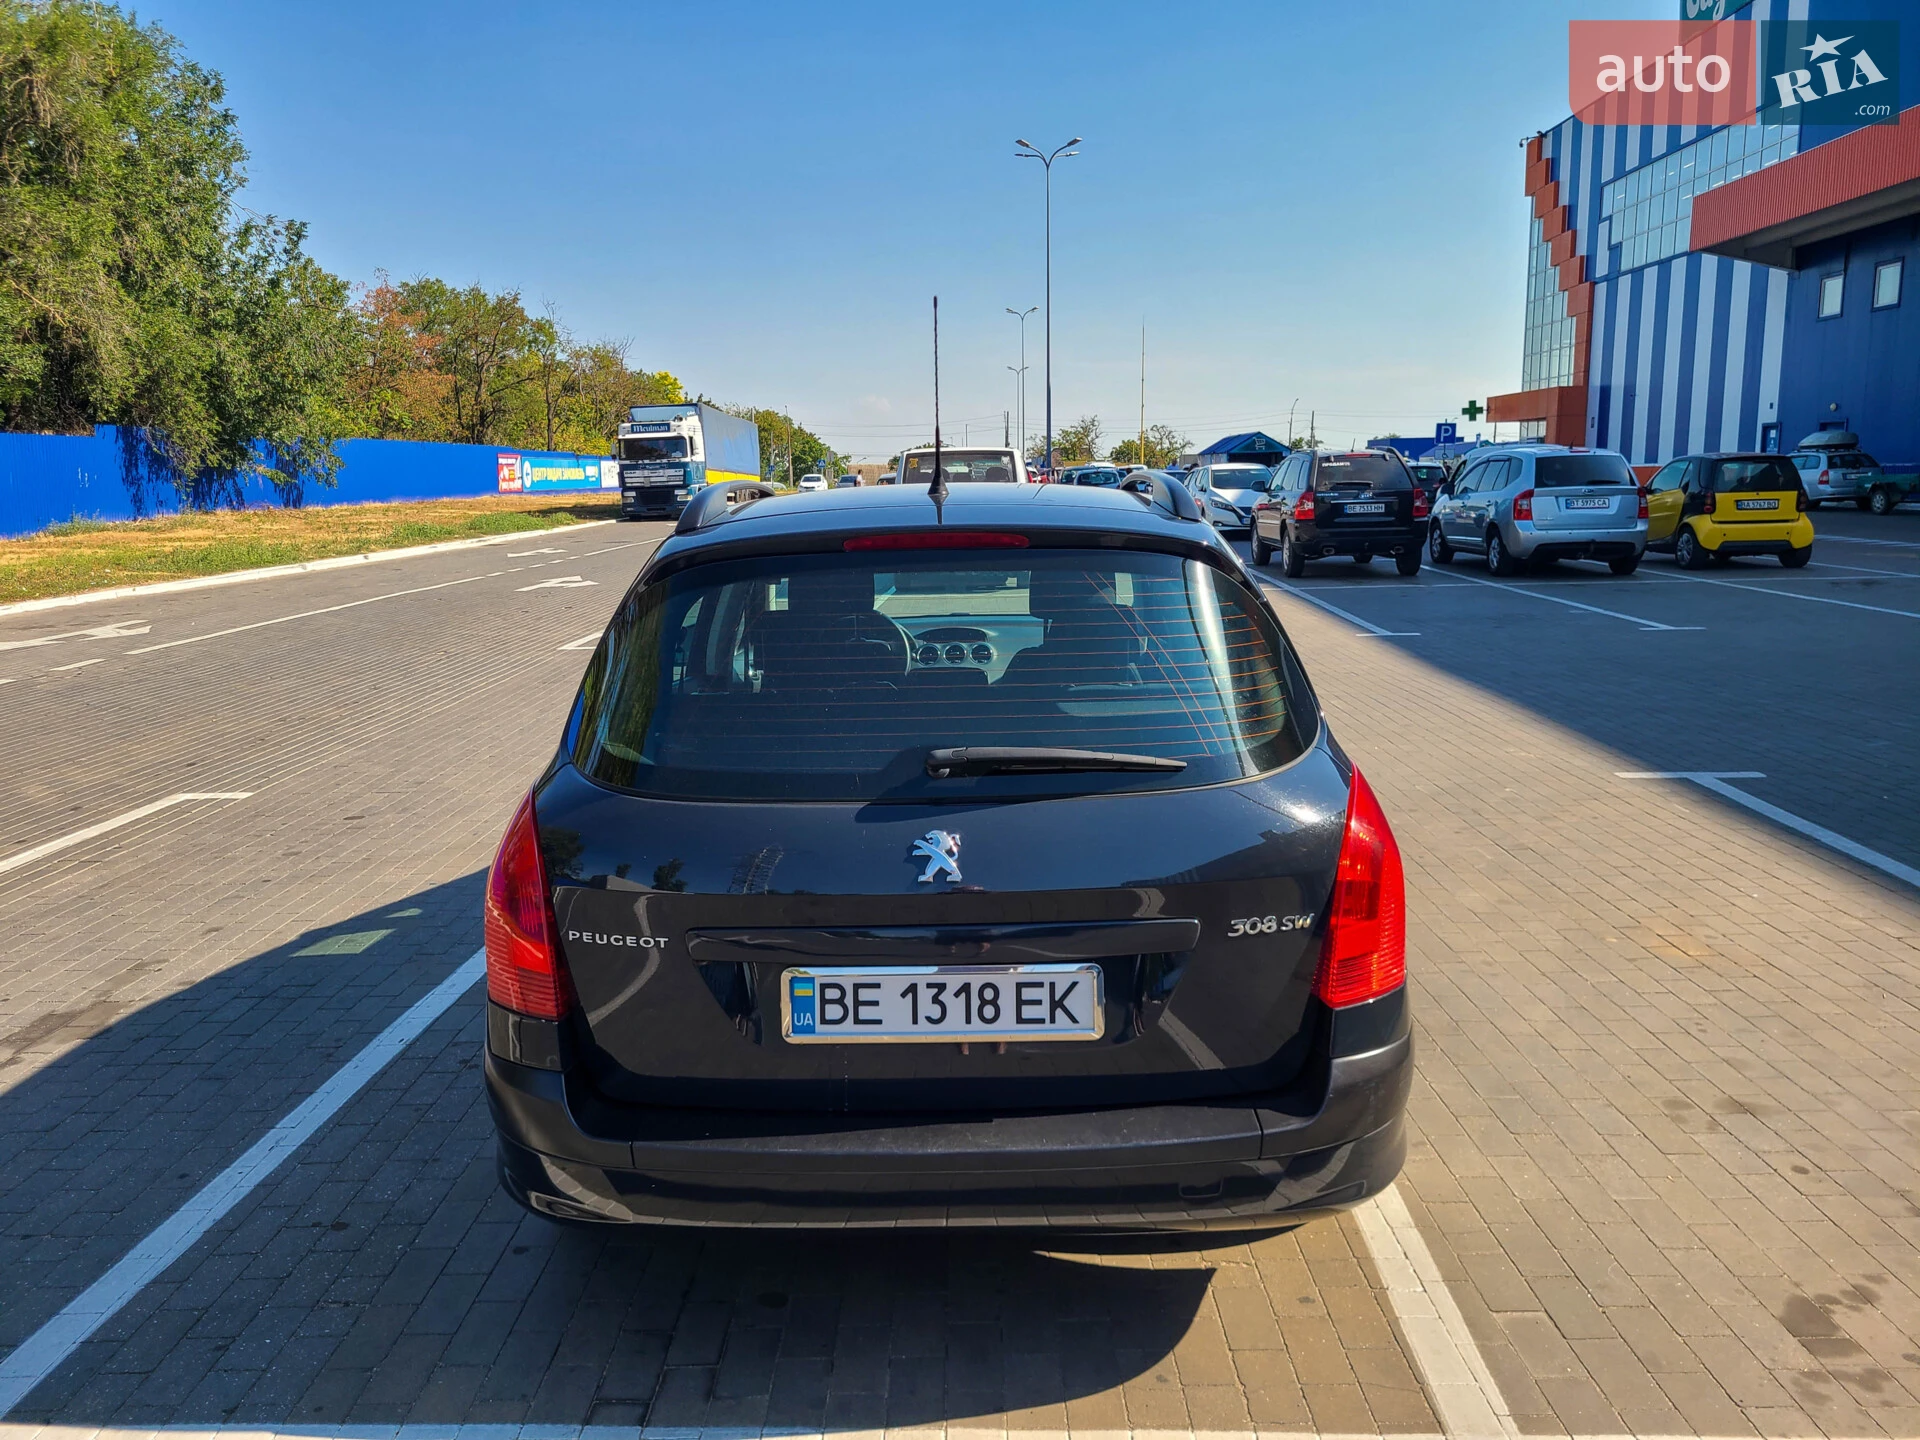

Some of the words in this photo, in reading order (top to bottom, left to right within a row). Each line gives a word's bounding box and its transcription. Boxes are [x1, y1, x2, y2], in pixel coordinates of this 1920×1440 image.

[1440, 425, 1452, 442] P
[568, 930, 669, 949] PEUGEOT
[819, 982, 883, 1025] BE
[900, 982, 1000, 1025] 1318
[1015, 981, 1080, 1025] EK
[794, 1012, 813, 1026] UA
